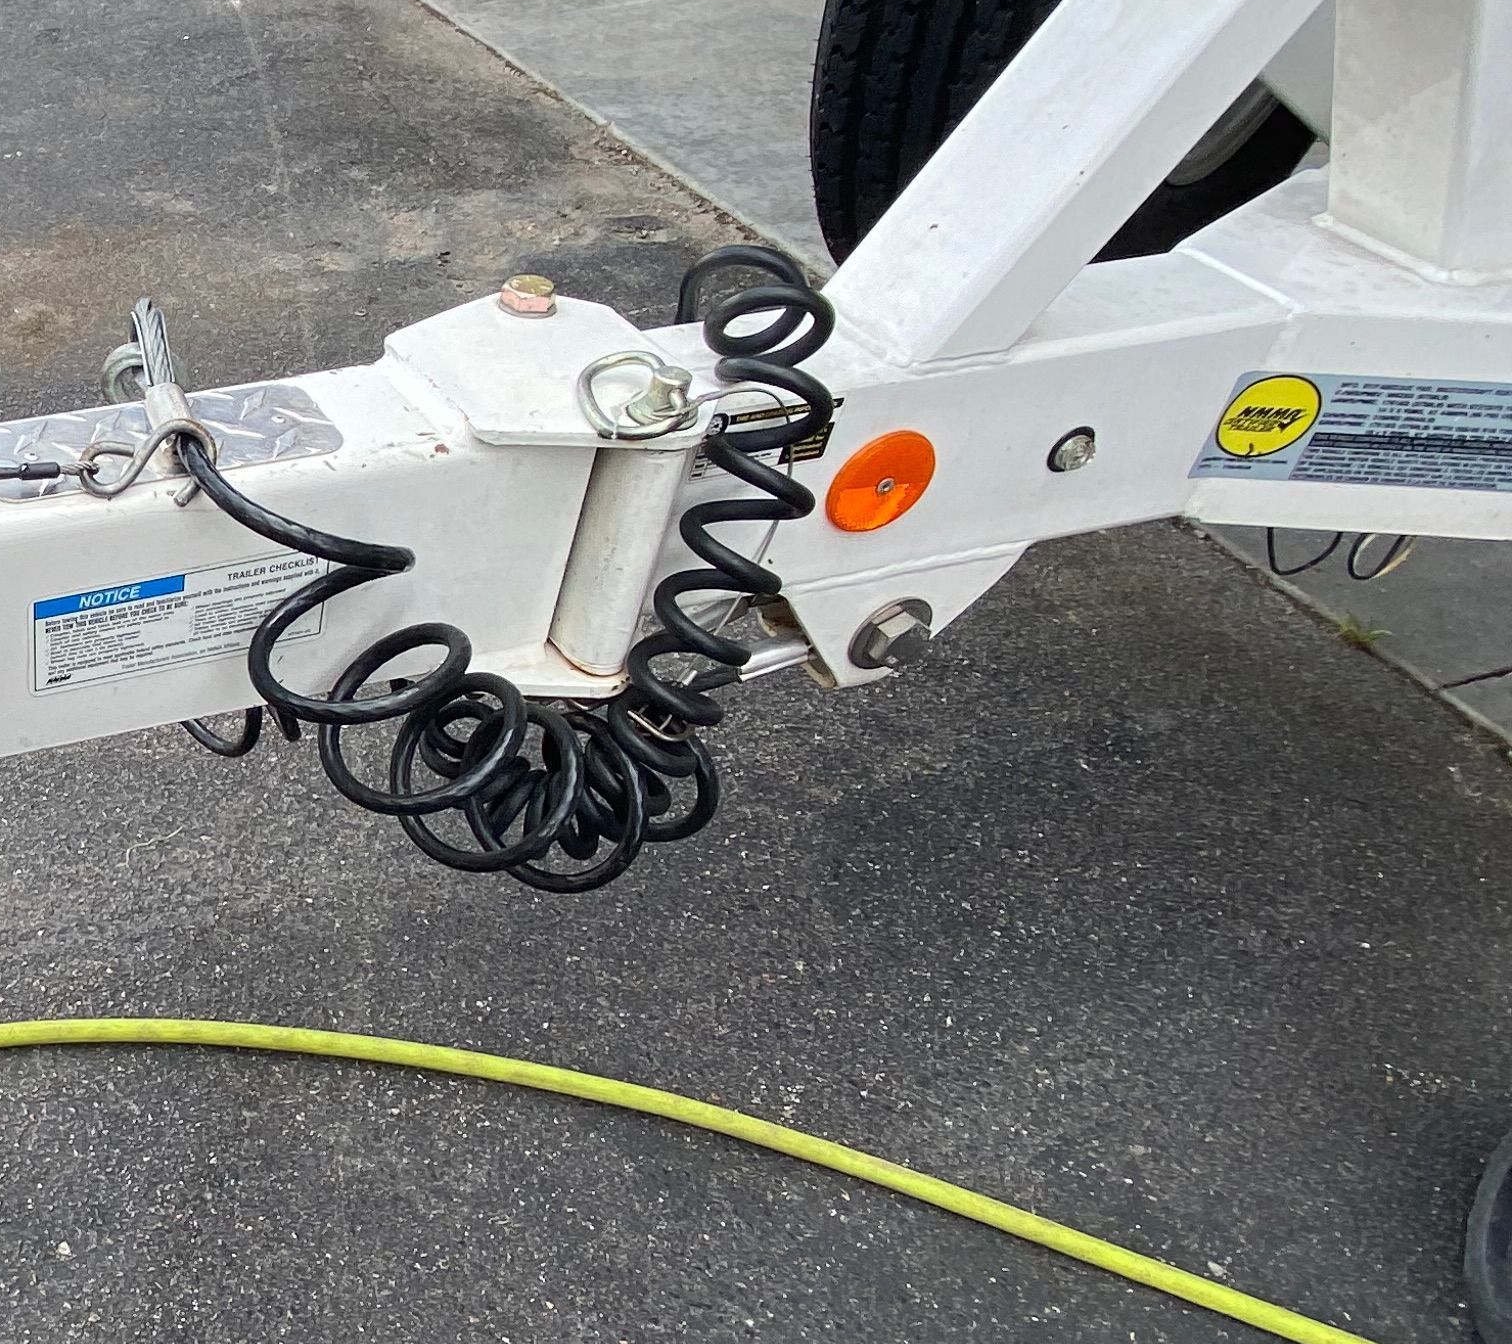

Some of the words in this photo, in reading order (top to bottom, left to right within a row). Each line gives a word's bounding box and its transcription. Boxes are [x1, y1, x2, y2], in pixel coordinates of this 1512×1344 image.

[227, 567, 267, 582] TRAILER
[268, 557, 320, 574] CHECKLIST
[78, 585, 143, 609] NOTICE
